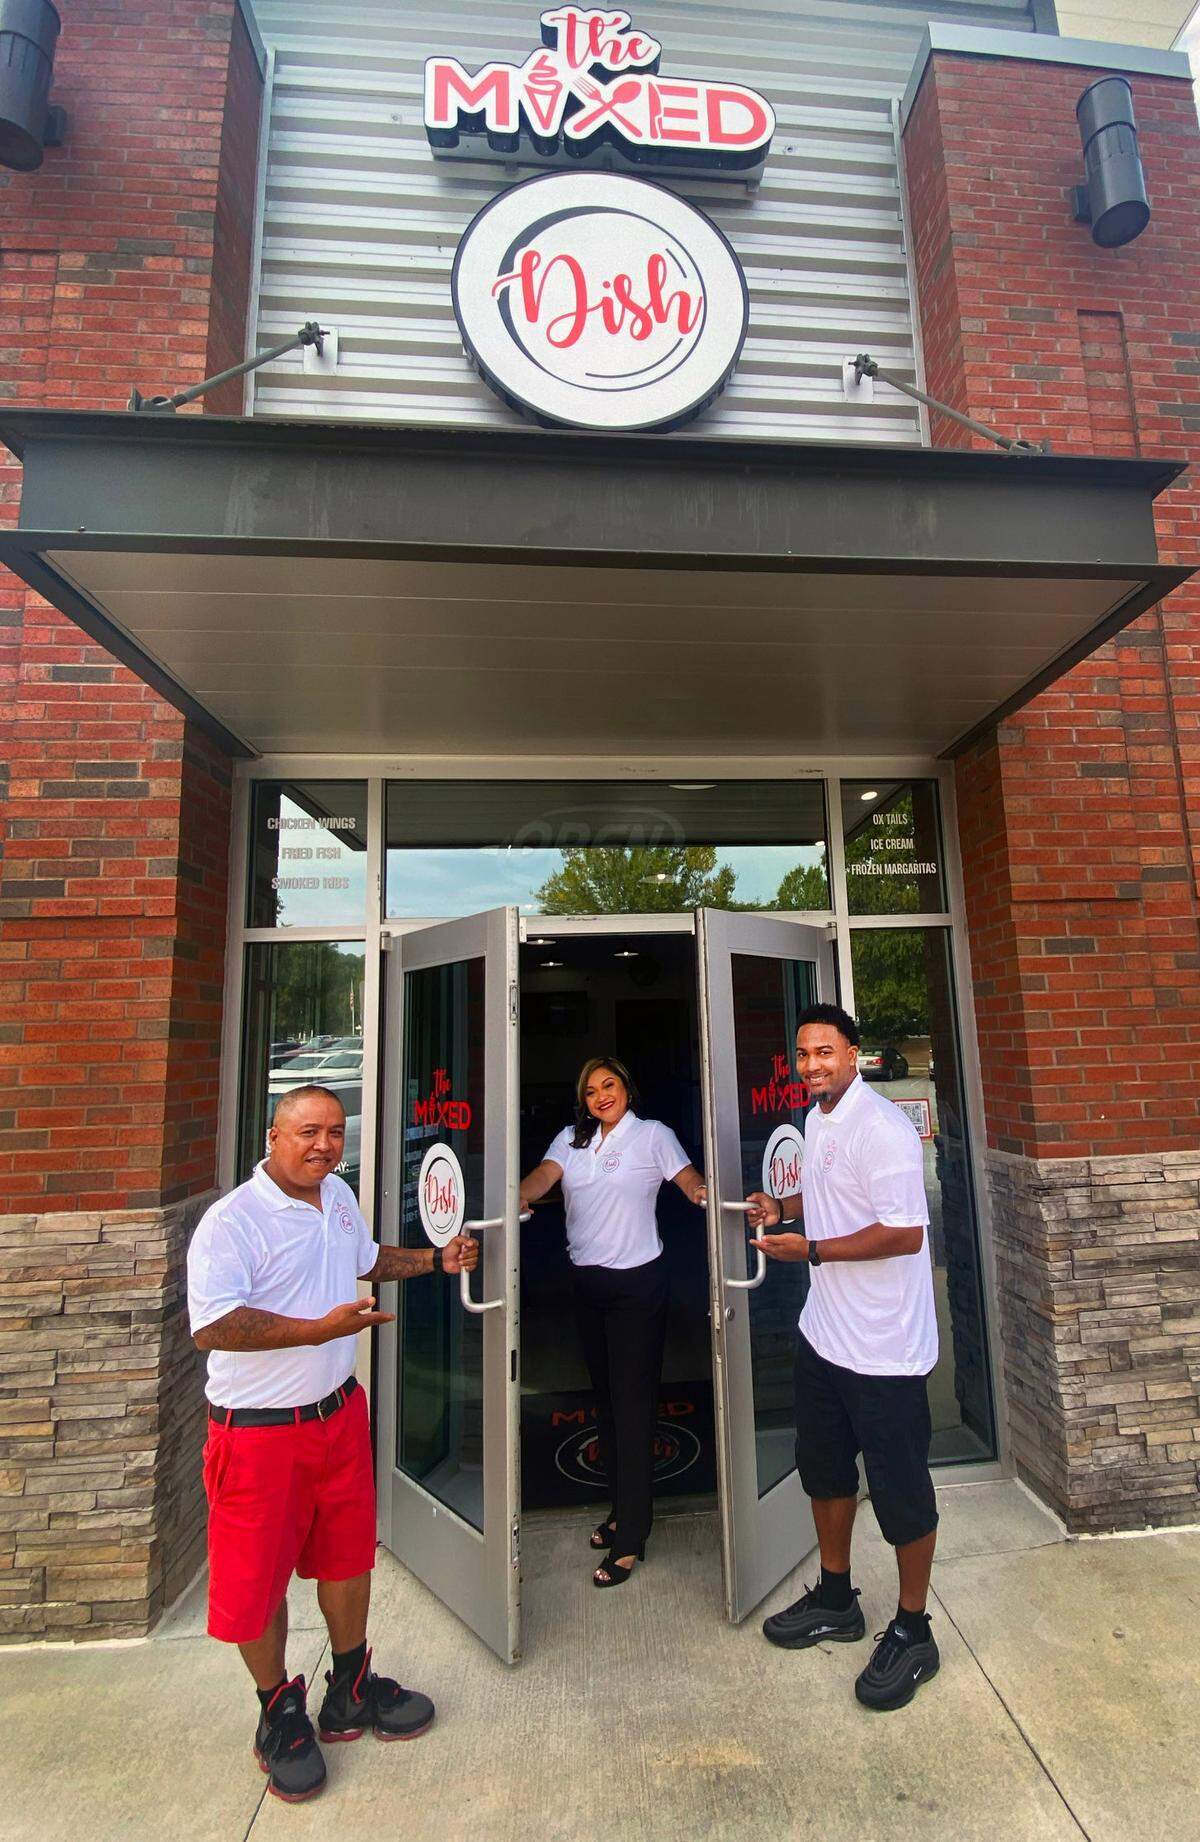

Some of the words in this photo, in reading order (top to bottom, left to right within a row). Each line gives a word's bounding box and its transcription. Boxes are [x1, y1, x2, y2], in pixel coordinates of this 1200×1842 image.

[550, 13, 653, 69] the
[492, 250, 703, 348] Dish
[319, 817, 356, 830] WINGS
[873, 814, 884, 825] OX
[886, 813, 908, 825] TAILS
[871, 838, 884, 850] ICE
[885, 838, 914, 850] CREAM
[851, 863, 883, 875] FROZEN
[884, 862, 937, 875] MARGARITAS
[426, 1174, 459, 1215] Dish
